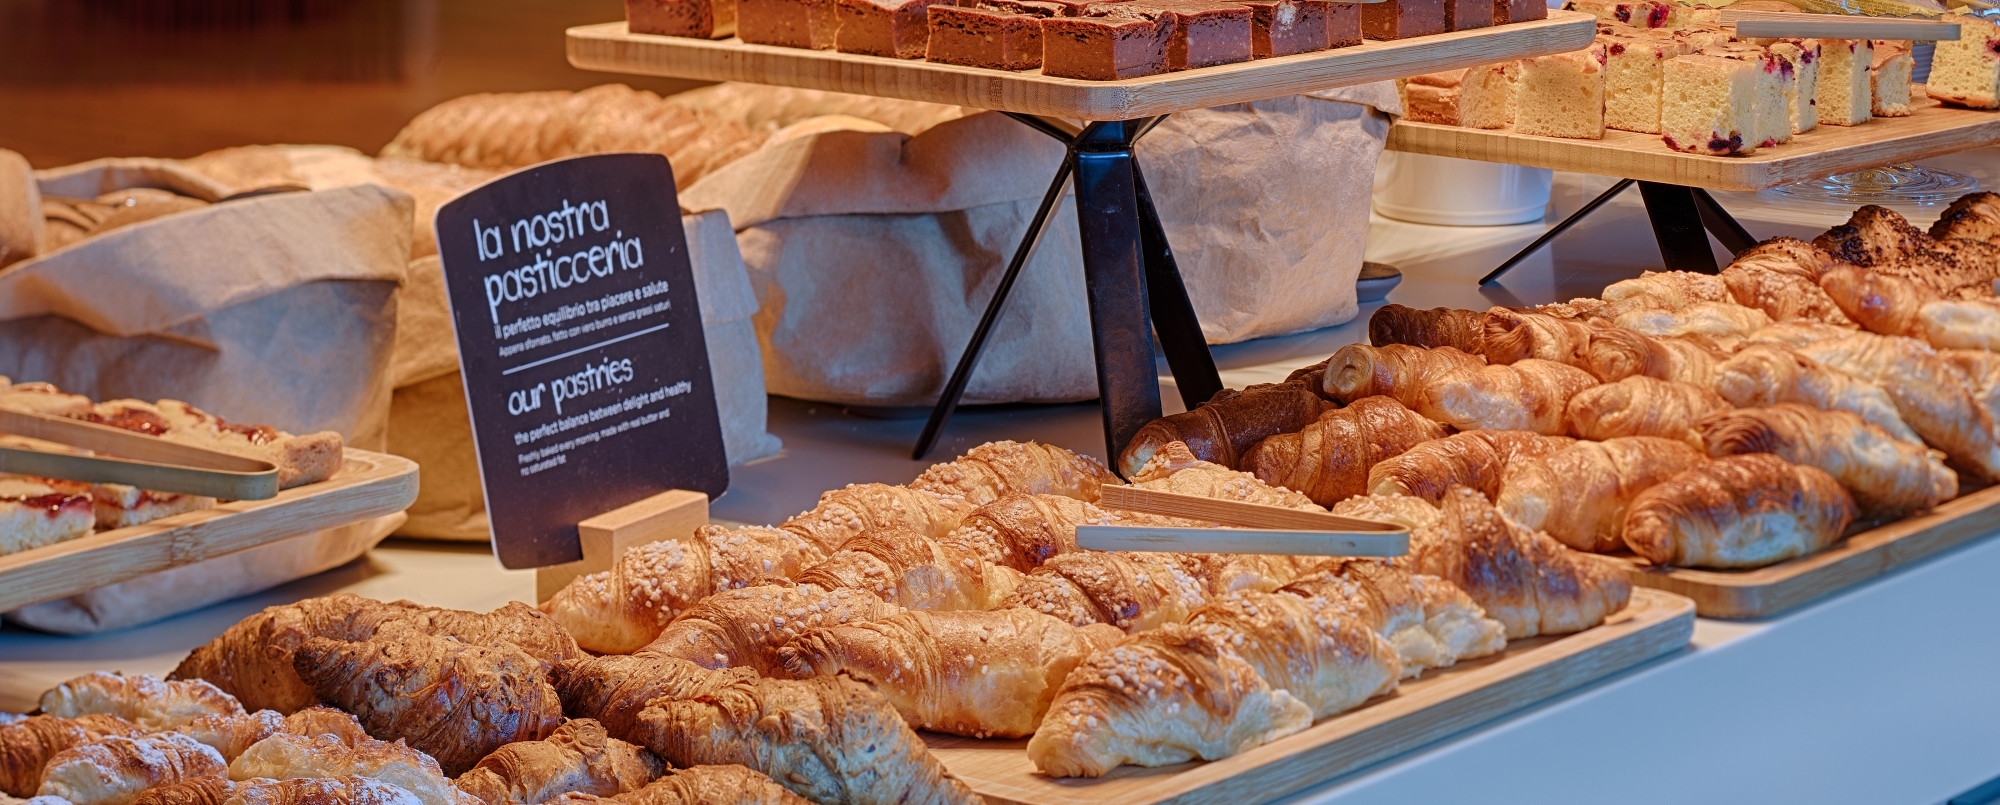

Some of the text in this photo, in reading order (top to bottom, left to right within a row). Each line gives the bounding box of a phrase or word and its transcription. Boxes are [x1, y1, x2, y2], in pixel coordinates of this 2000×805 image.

[473, 199, 610, 262] la nostra
[484, 230, 644, 324] pasticceria
[499, 342, 525, 358] Appena
[552, 329, 569, 342] fatto
[568, 326, 581, 338] con
[581, 321, 596, 334] vero
[595, 317, 613, 330] burro
[613, 315, 618, 325] e
[618, 310, 636, 324] senza
[636, 303, 654, 320] grassi
[653, 298, 671, 313] saturi
[502, 316, 542, 340] perfetto
[542, 302, 586, 327] equilibrio
[586, 300, 601, 314] tra
[600, 290, 634, 312] piacere
[634, 288, 642, 300] e
[642, 280, 669, 298] salute
[508, 356, 634, 416] our pastries
[514, 380, 692, 446] the perfect balance between delight and healthy
[518, 450, 540, 465] Freshly
[540, 443, 559, 458] baked
[558, 440, 575, 452] every
[600, 425, 617, 438] made
[617, 420, 630, 433] with
[629, 416, 641, 429] real
[640, 412, 659, 425] butter
[658, 407, 671, 420] and
[520, 466, 530, 477] no
[529, 455, 558, 475] saturated
